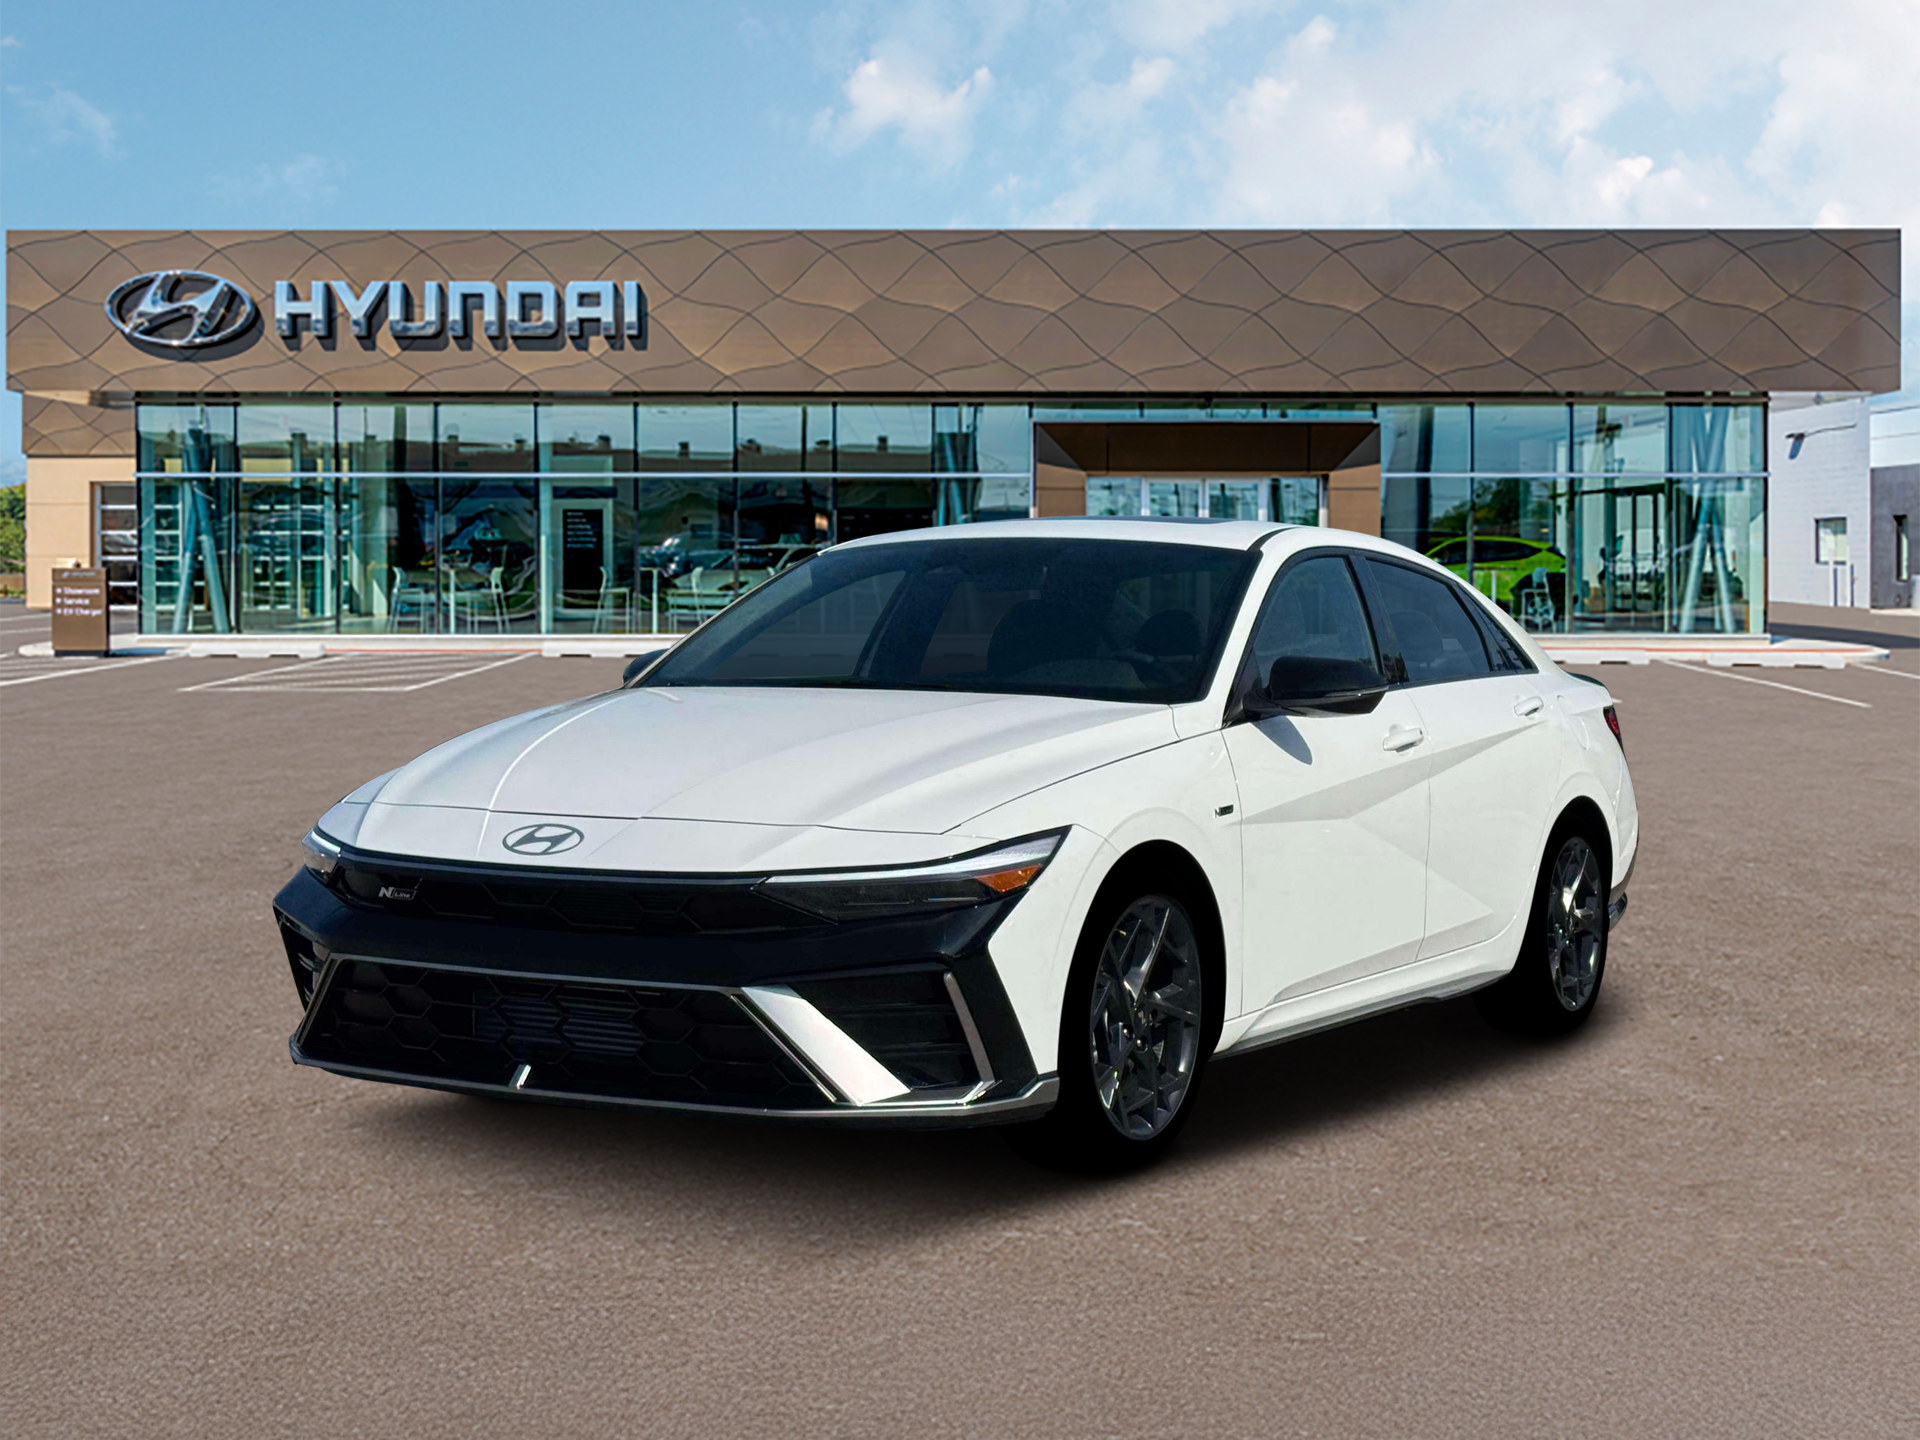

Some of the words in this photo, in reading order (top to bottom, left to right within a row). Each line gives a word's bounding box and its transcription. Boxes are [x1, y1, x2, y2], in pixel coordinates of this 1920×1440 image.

[274, 280, 642, 340] HYUNDAI
[63, 587, 100, 595] Showroom
[63, 597, 90, 605] Service
[75, 608, 103, 617] Charger
